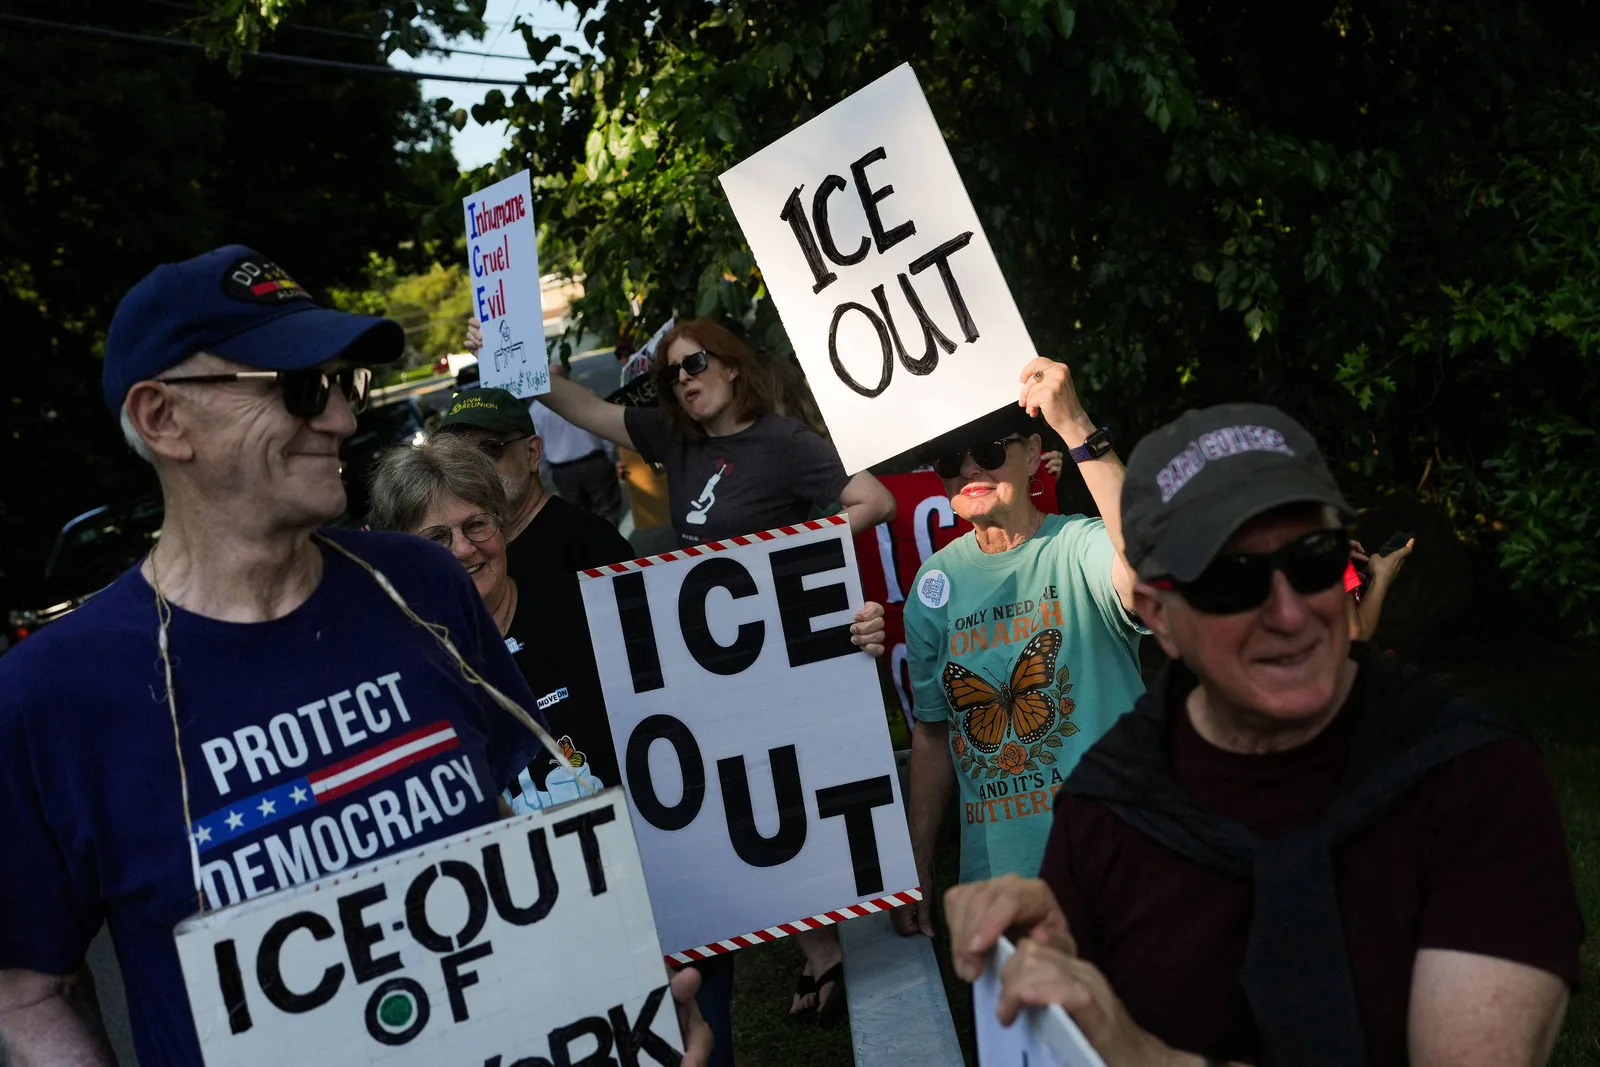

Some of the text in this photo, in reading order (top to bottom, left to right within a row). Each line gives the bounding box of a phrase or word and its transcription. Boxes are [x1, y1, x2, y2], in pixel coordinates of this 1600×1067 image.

[467, 193, 526, 240] Inhumane
[473, 235, 510, 278] Cruel
[780, 146, 917, 295] ICE
[477, 279, 506, 323] Evil
[828, 231, 980, 399] OUT
[462, 402, 498, 410] REUNION
[612, 537, 862, 695] ICE
[955, 608, 988, 631] ONLY
[993, 599, 1034, 621] NEED
[201, 671, 412, 796] PROTECT
[979, 767, 1064, 800] AND IT'S A
[199, 755, 485, 910] DEMOCRACY
[625, 713, 895, 898] OUT
[364, 940, 494, 1046] OF
